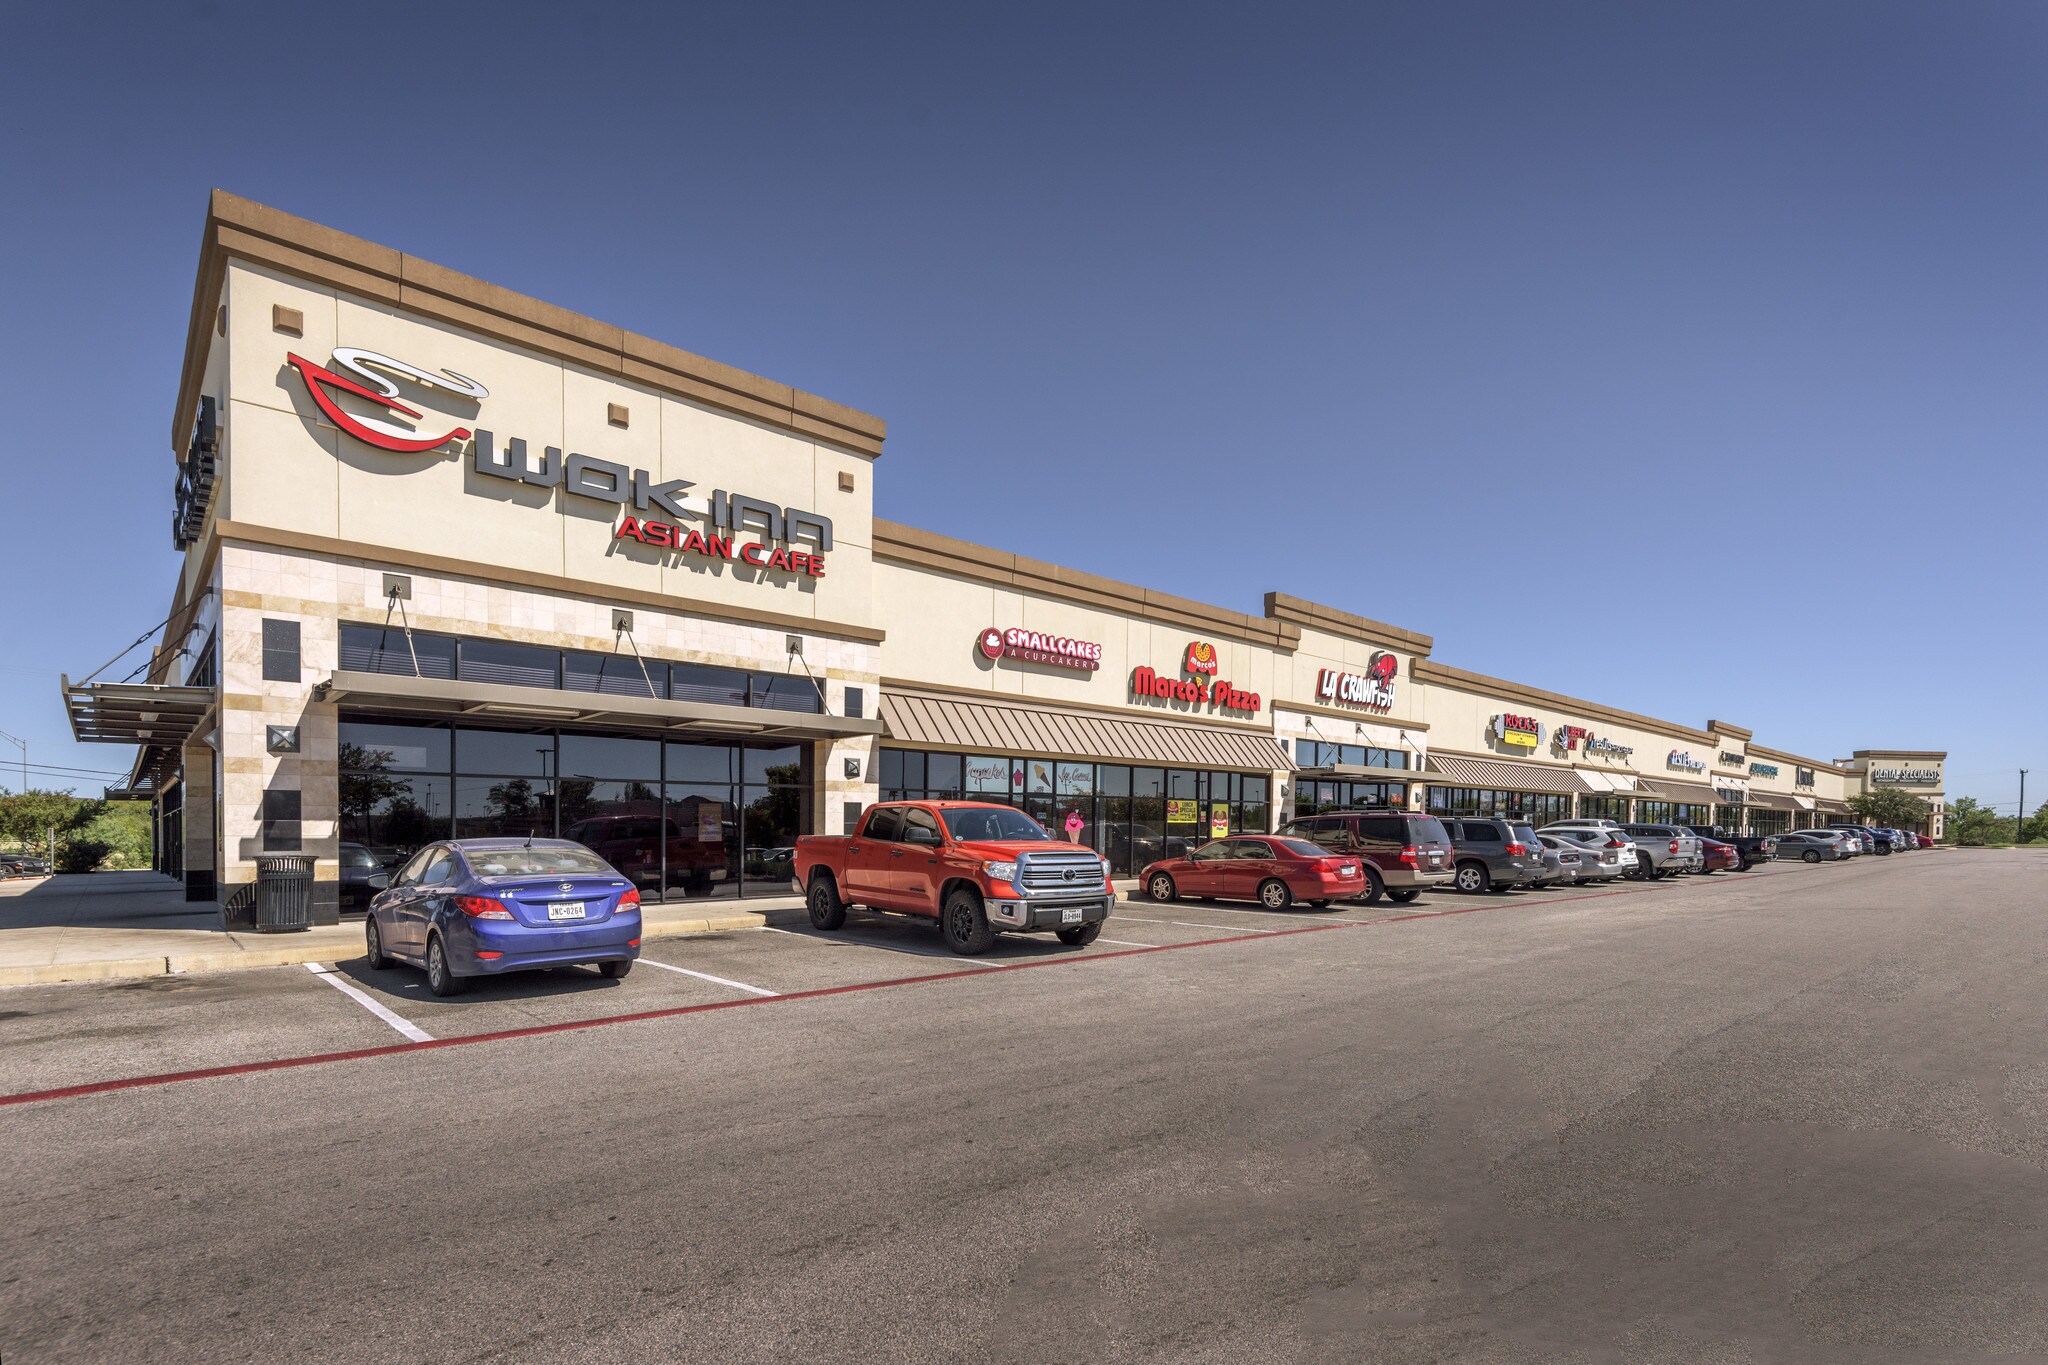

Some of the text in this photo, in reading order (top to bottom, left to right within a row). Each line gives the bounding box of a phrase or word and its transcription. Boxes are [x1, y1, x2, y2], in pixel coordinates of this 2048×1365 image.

[615, 516, 825, 578] ASIAN CAFE
[1006, 627, 1102, 661] SMALLCAKES
[1010, 648, 1096, 670] A CUPCAKERY
[1214, 679, 1261, 712] Pizza
[1317, 668, 1396, 709] LA CRAWFISH
[1505, 713, 1538, 732] ROCK'S
[1567, 725, 1587, 739] LIBERTY
[1875, 769, 1940, 780] DENTAL SPECIALISTS
[550, 906, 583, 917] JNC-0264
